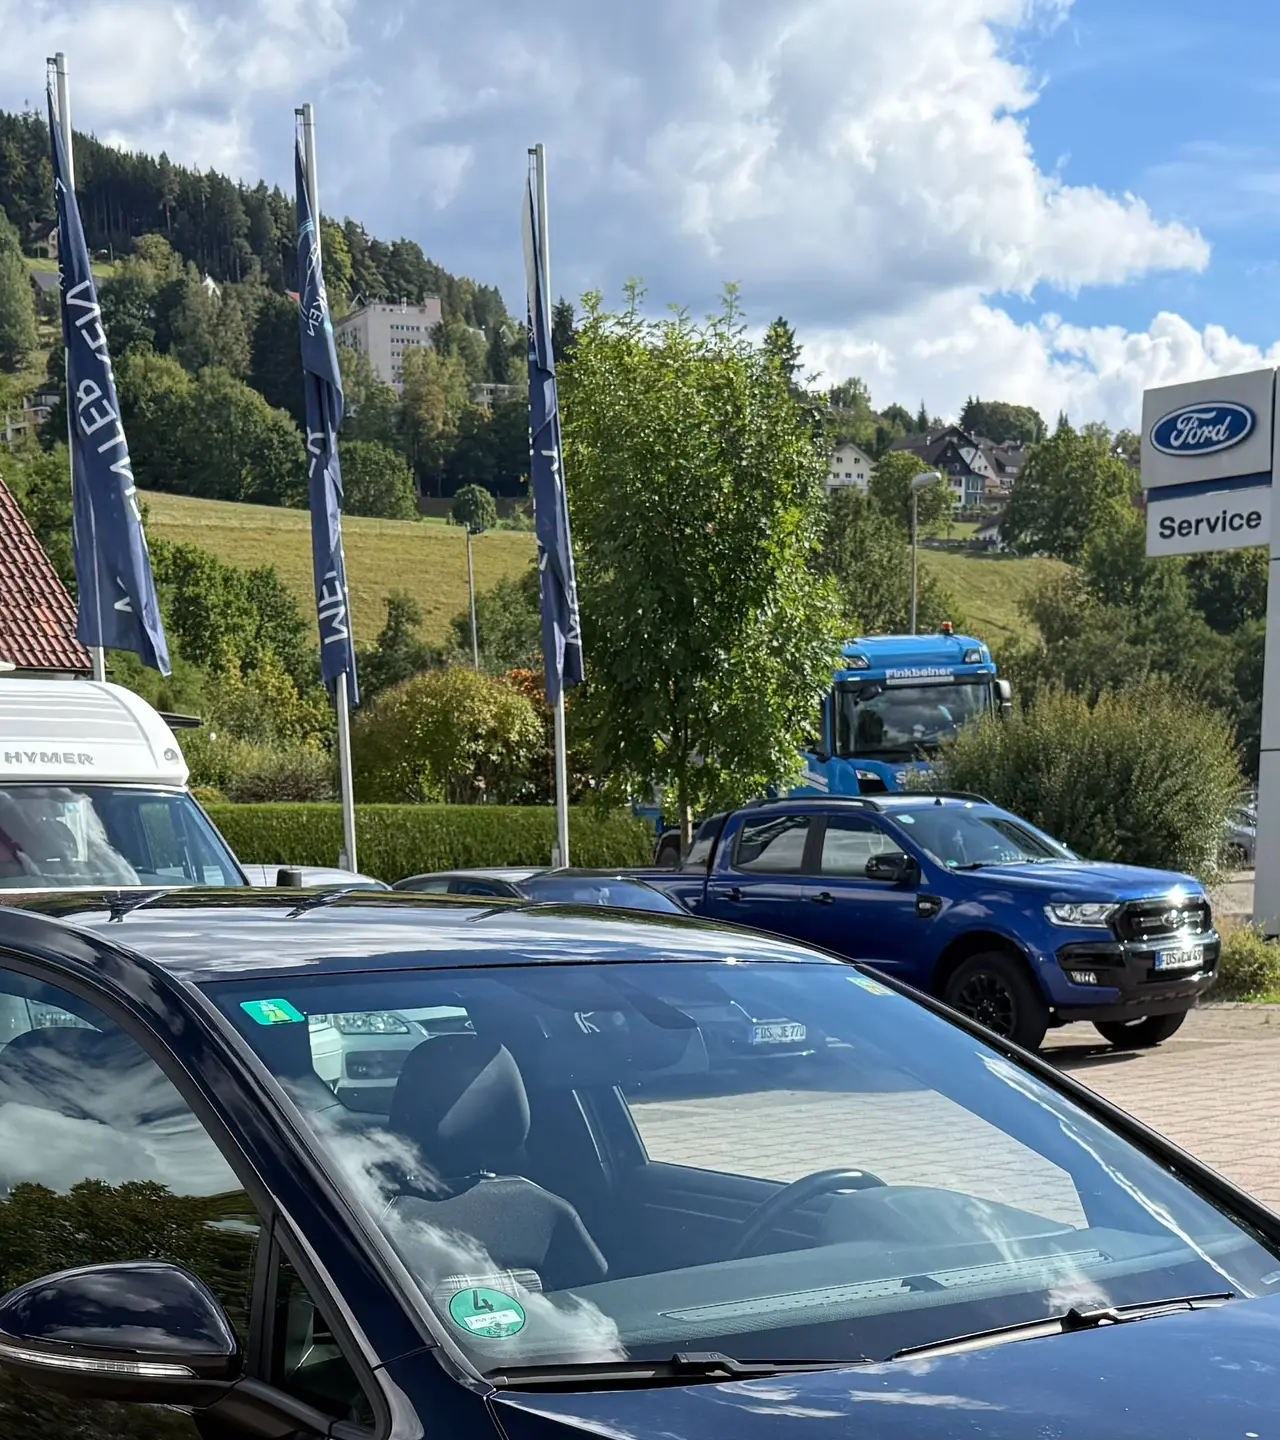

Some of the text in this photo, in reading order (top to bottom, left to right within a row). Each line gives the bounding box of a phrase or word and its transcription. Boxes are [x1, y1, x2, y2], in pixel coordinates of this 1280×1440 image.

[1170, 411, 1231, 447] Ford
[1159, 510, 1262, 539] Service
[885, 667, 954, 678] Finkbeiner
[4, 751, 96, 765] HYMER
[754, 1027, 772, 1039] FDS
[472, 1290, 495, 1312] 4
